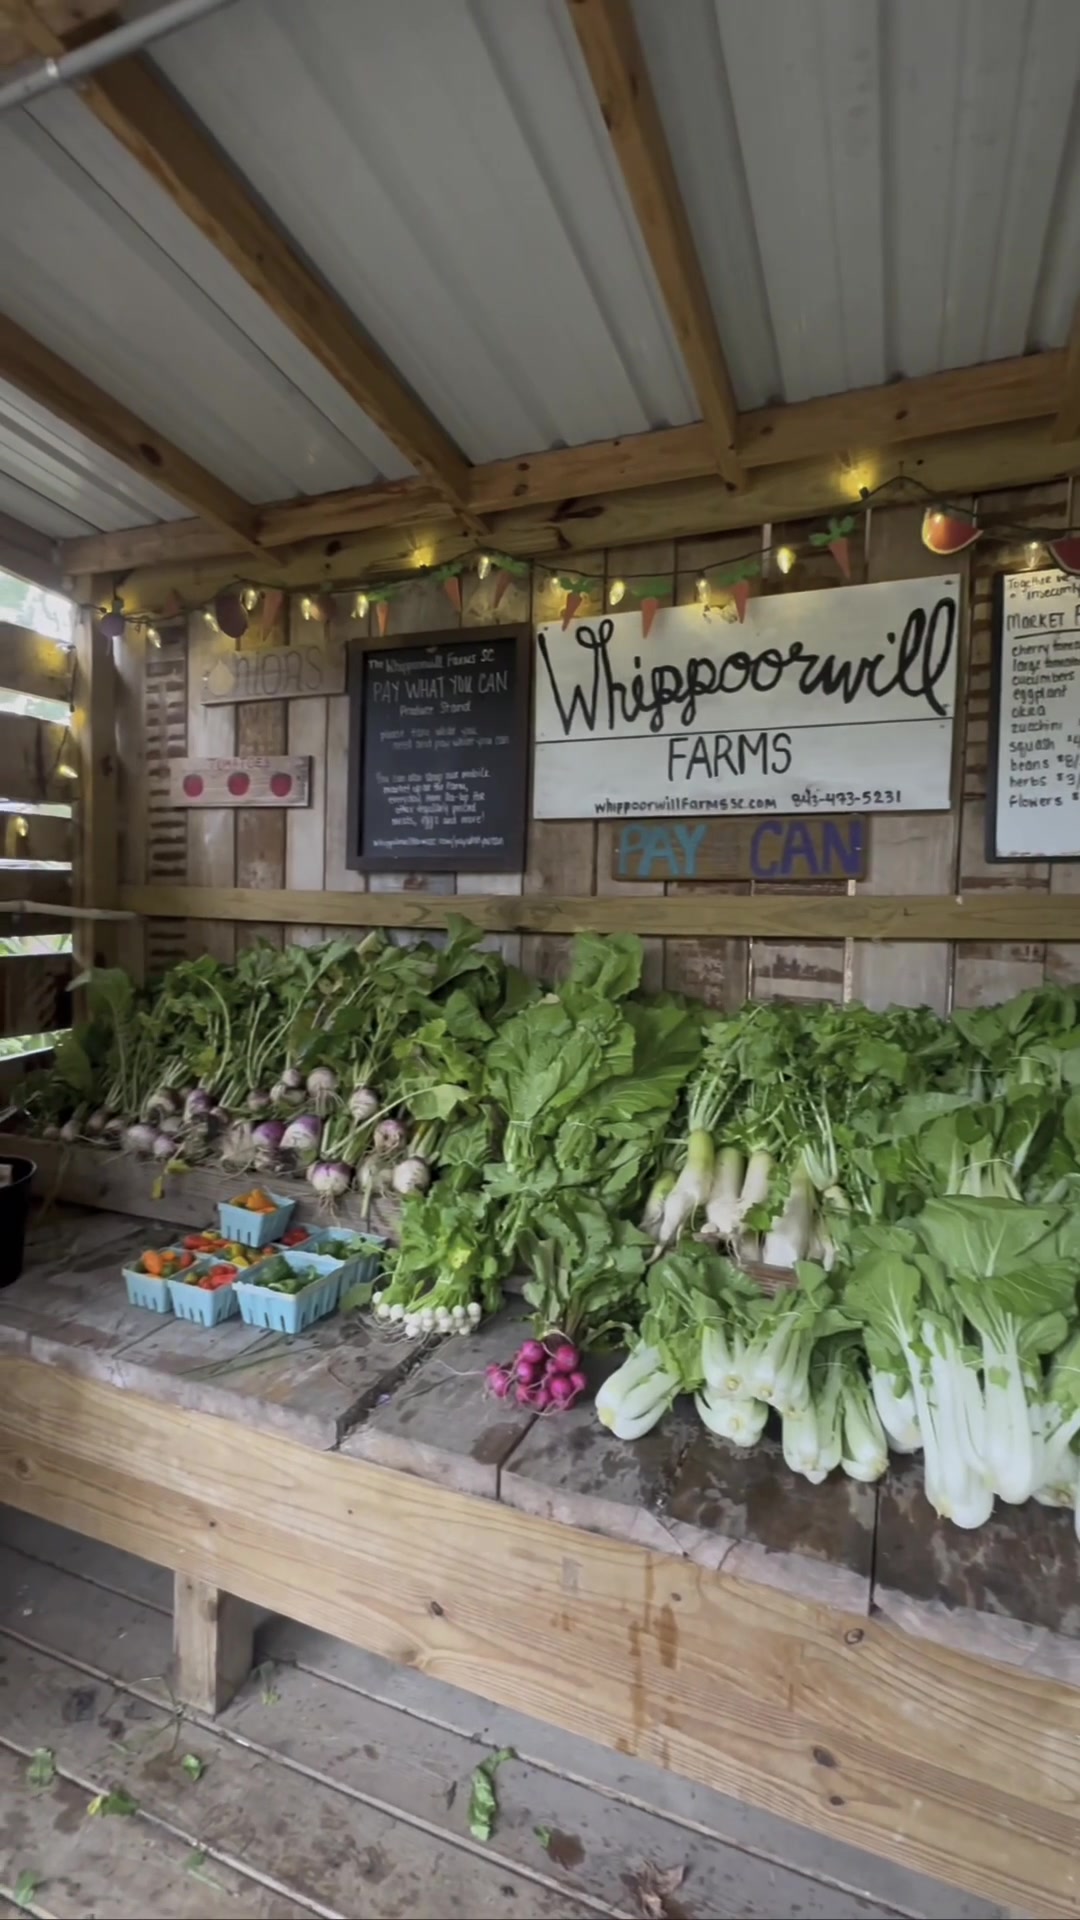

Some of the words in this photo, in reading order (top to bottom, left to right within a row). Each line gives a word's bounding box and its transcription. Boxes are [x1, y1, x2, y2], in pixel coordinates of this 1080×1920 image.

[1011, 644, 1050, 660] cherry
[538, 597, 957, 736] Whippoorwill
[372, 680, 401, 704] PAY
[404, 676, 445, 700] WHAT
[448, 674, 473, 695] YOU
[477, 669, 509, 695] CAN
[1012, 671, 1075, 686] cucumbers
[1012, 685, 1067, 705] eggplant
[1010, 719, 1063, 734] zucchini
[667, 731, 793, 782] FARMS
[1009, 738, 1056, 758] squash
[1010, 757, 1050, 772] beans
[1009, 775, 1048, 788] herbs
[790, 787, 903, 807] 843-473-5231
[616, 822, 712, 877] PAY
[750, 818, 866, 879] CAN
